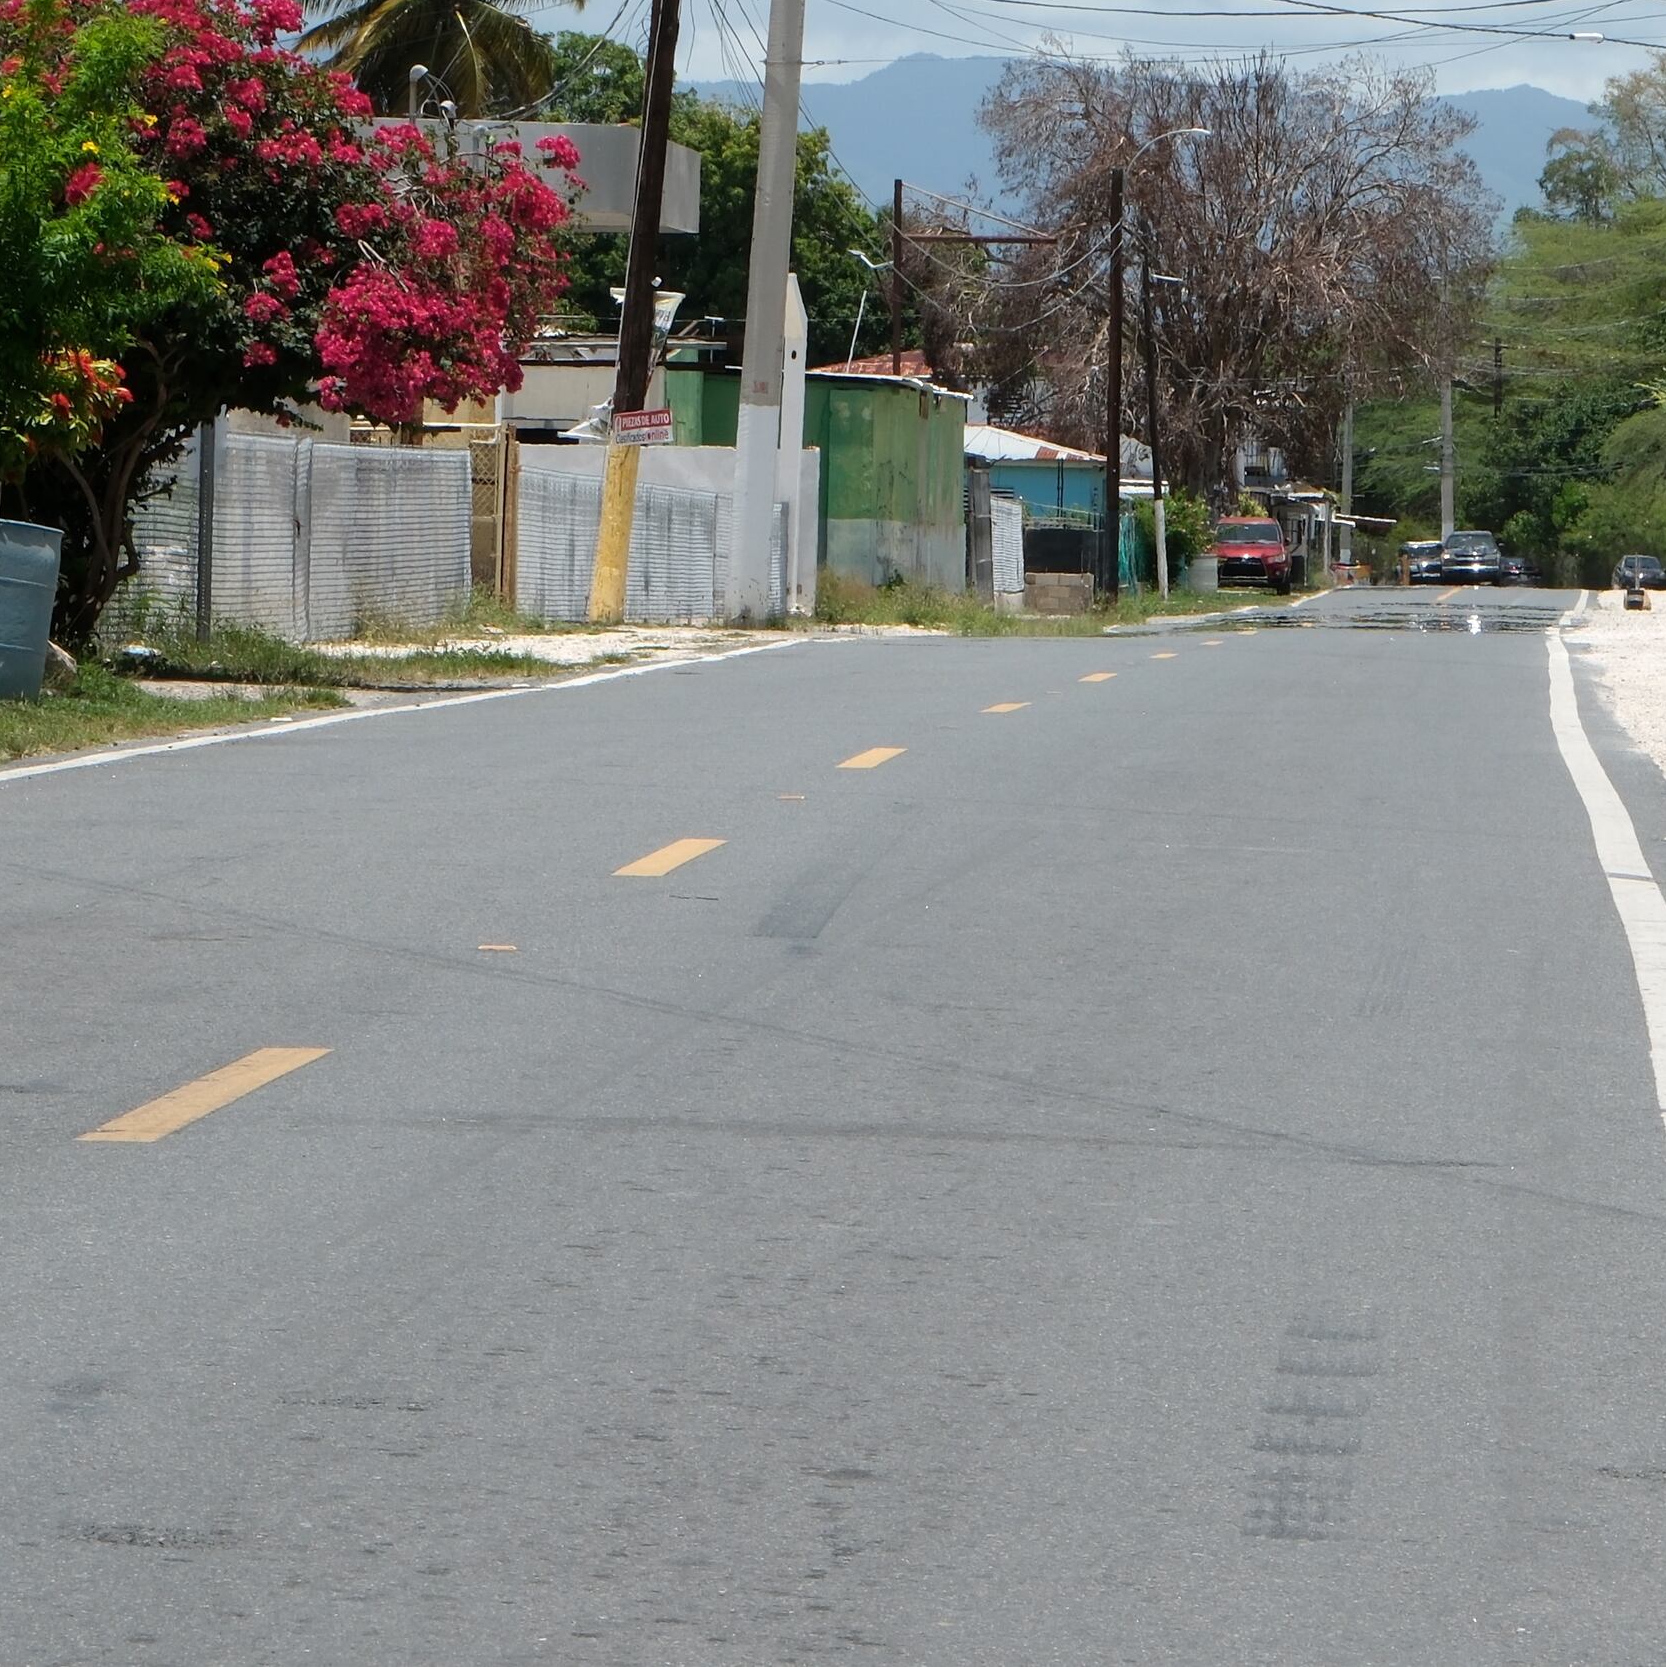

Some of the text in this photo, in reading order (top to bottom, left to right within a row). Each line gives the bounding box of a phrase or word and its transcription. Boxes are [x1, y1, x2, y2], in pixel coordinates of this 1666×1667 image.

[622, 413, 670, 428] PIEZAS DE AUTO
